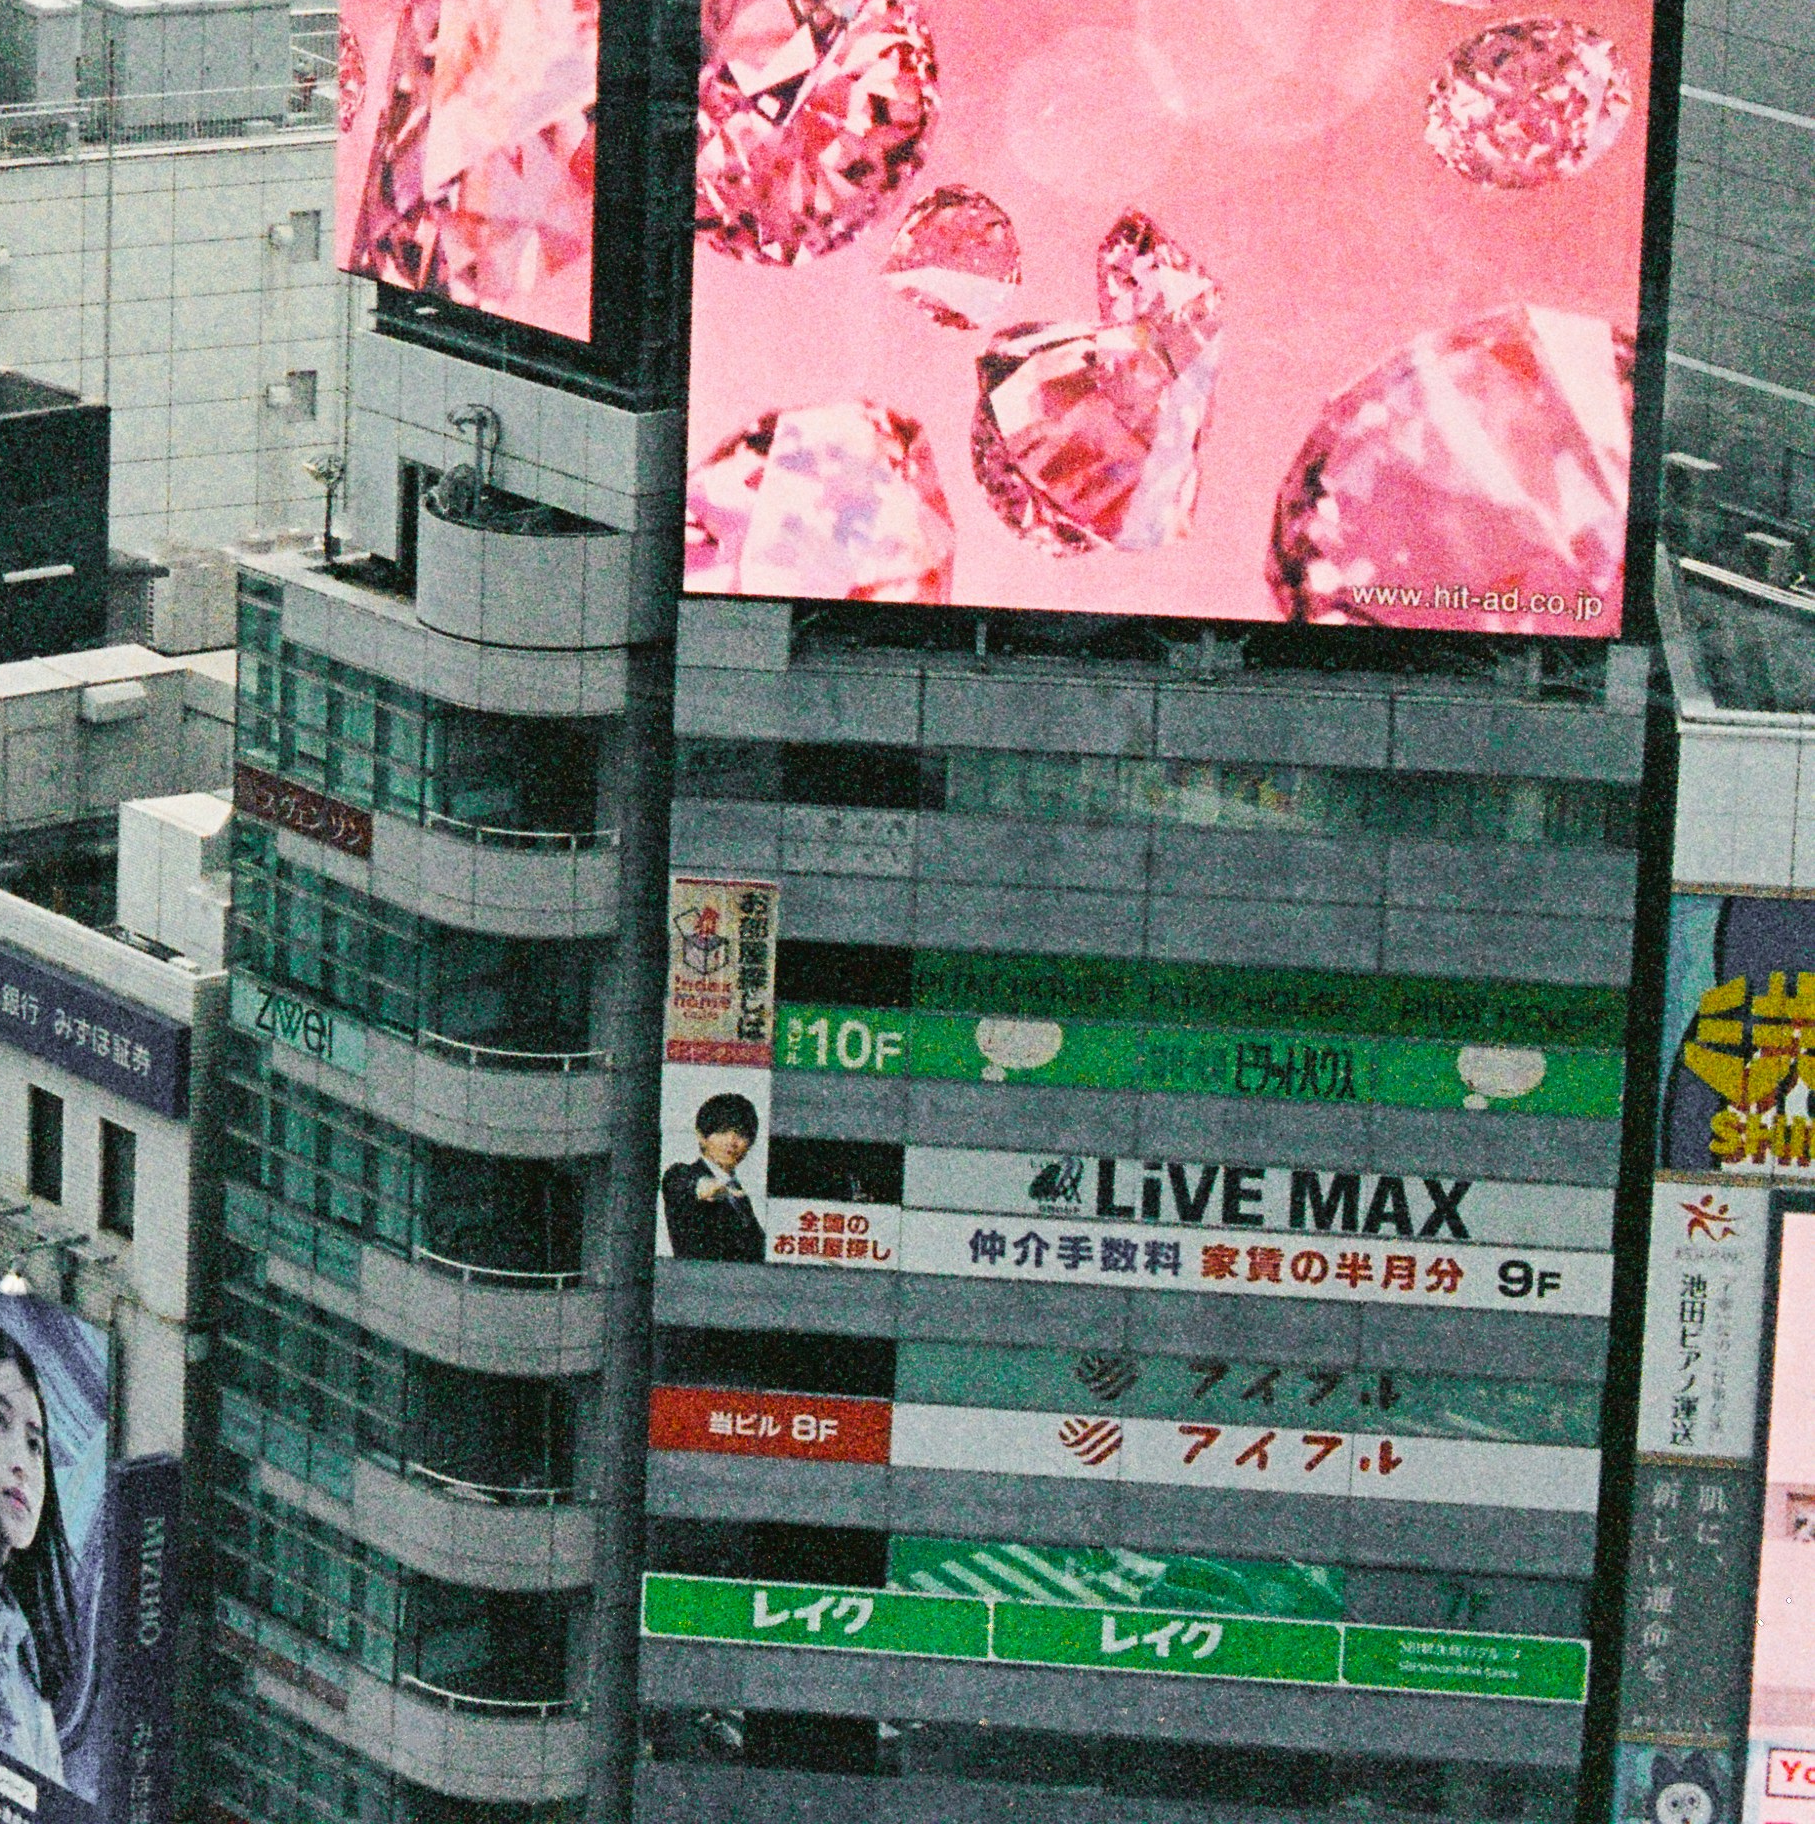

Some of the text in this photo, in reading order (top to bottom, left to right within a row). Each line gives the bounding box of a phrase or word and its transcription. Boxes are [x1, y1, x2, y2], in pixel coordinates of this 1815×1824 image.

[1351, 584, 1604, 620] www.hit-ad.co.jp
[54, 1007, 151, 1078] みずほ証券
[807, 1018, 904, 1071] 10F
[797, 1211, 869, 1236] 全国の
[1095, 1160, 1472, 1240] LiVE MAX
[773, 1236, 892, 1263] お部屋探し
[969, 1228, 1562, 1300] 仲介手数料 家賃の半月分 9F
[1669, 1272, 1708, 1447] 池田ピアノ運送
[709, 1411, 839, 1443] 当ビル 8F
[1178, 1425, 1404, 1475] アイフル
[136, 1516, 165, 1647] MIZUHO
[752, 1594, 874, 1633] レイク
[1100, 1614, 1224, 1658] レイク
